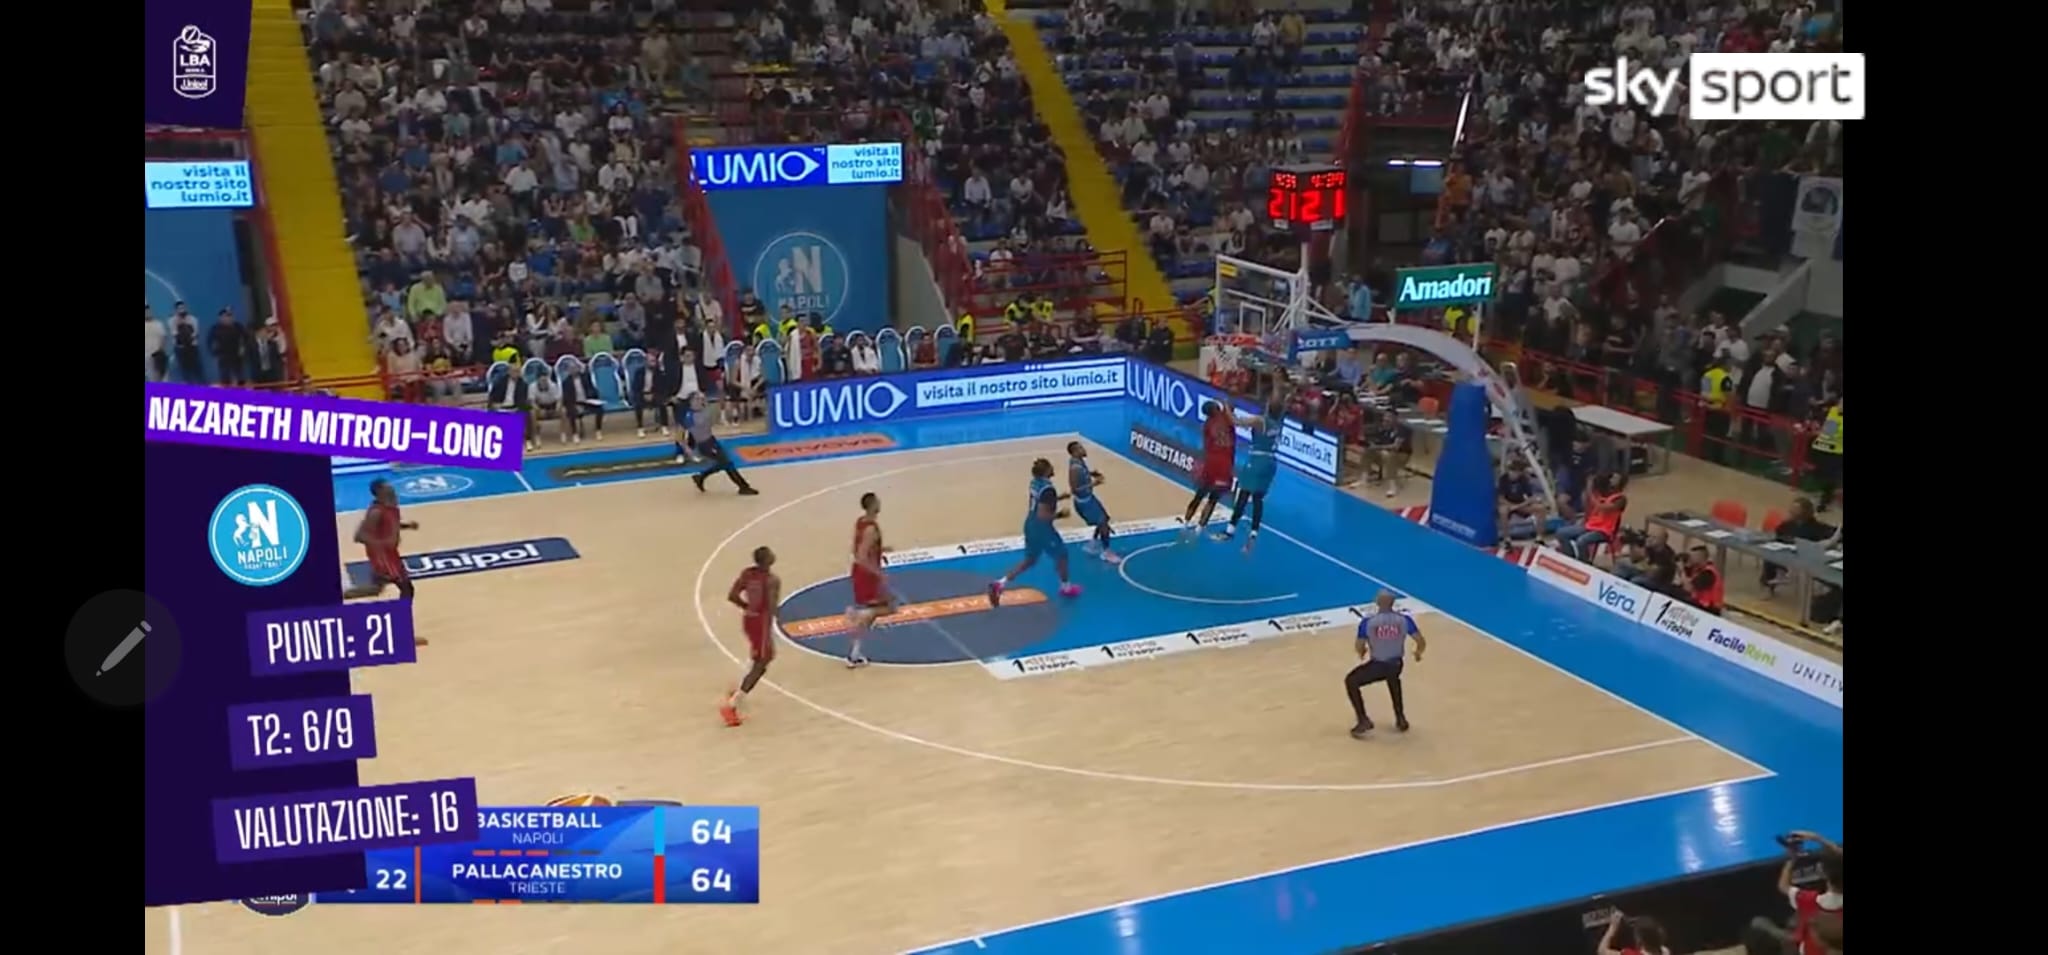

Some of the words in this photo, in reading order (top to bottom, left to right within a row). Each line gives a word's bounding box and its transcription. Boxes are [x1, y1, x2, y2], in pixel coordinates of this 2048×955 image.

[854, 147, 888, 157] visita
[892, 146, 900, 156] il
[182, 165, 230, 177] visita
[235, 165, 246, 177] il
[832, 159, 873, 169] nostro
[877, 157, 900, 167] sito
[151, 178, 210, 190] nostro
[214, 177, 247, 190] sito
[851, 168, 901, 180] lumio.it
[181, 190, 249, 202] lumio.it
[1301, 189, 1345, 221] 21
[1399, 271, 1493, 301] Amadori
[1126, 359, 1194, 417] LUMIO
[774, 381, 908, 428] LUMIO
[923, 384, 964, 401] visita
[967, 382, 976, 397] il
[979, 380, 1028, 395] nostro
[1031, 377, 1058, 391] sito
[1061, 371, 1119, 389] lumio.it
[1130, 430, 1194, 472] POKERSTARS
[402, 543, 542, 573] Unipol
